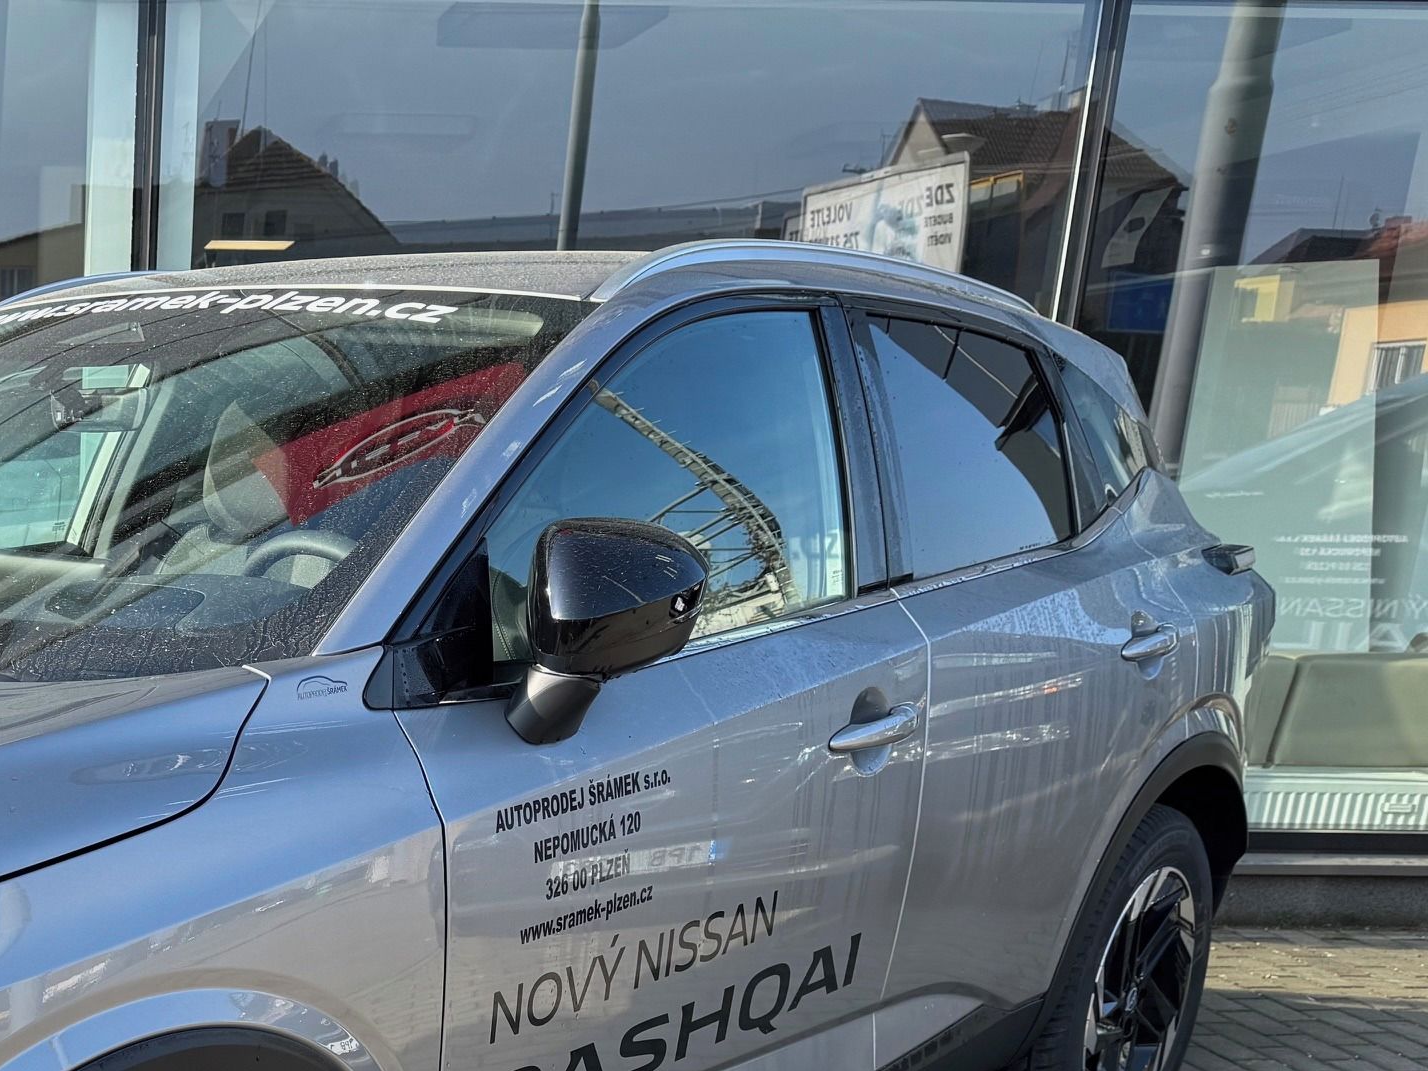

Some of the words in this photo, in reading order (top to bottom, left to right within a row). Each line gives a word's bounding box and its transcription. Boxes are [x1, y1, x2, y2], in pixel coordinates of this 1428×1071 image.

[495, 787, 585, 834] AUTOPRODEJ
[588, 771, 641, 806] ŠRÁMEK
[643, 768, 671, 790] s.r.o.
[534, 815, 617, 863] NEPOMUCKÁ
[620, 811, 641, 836] 120
[545, 877, 569, 900] 326
[572, 867, 587, 891] 00
[591, 849, 631, 886] PLZEŇ
[520, 885, 653, 945] www.sramek-plzen.cz
[489, 933, 625, 1045] NOVÝ
[633, 890, 779, 990] NISSAN
